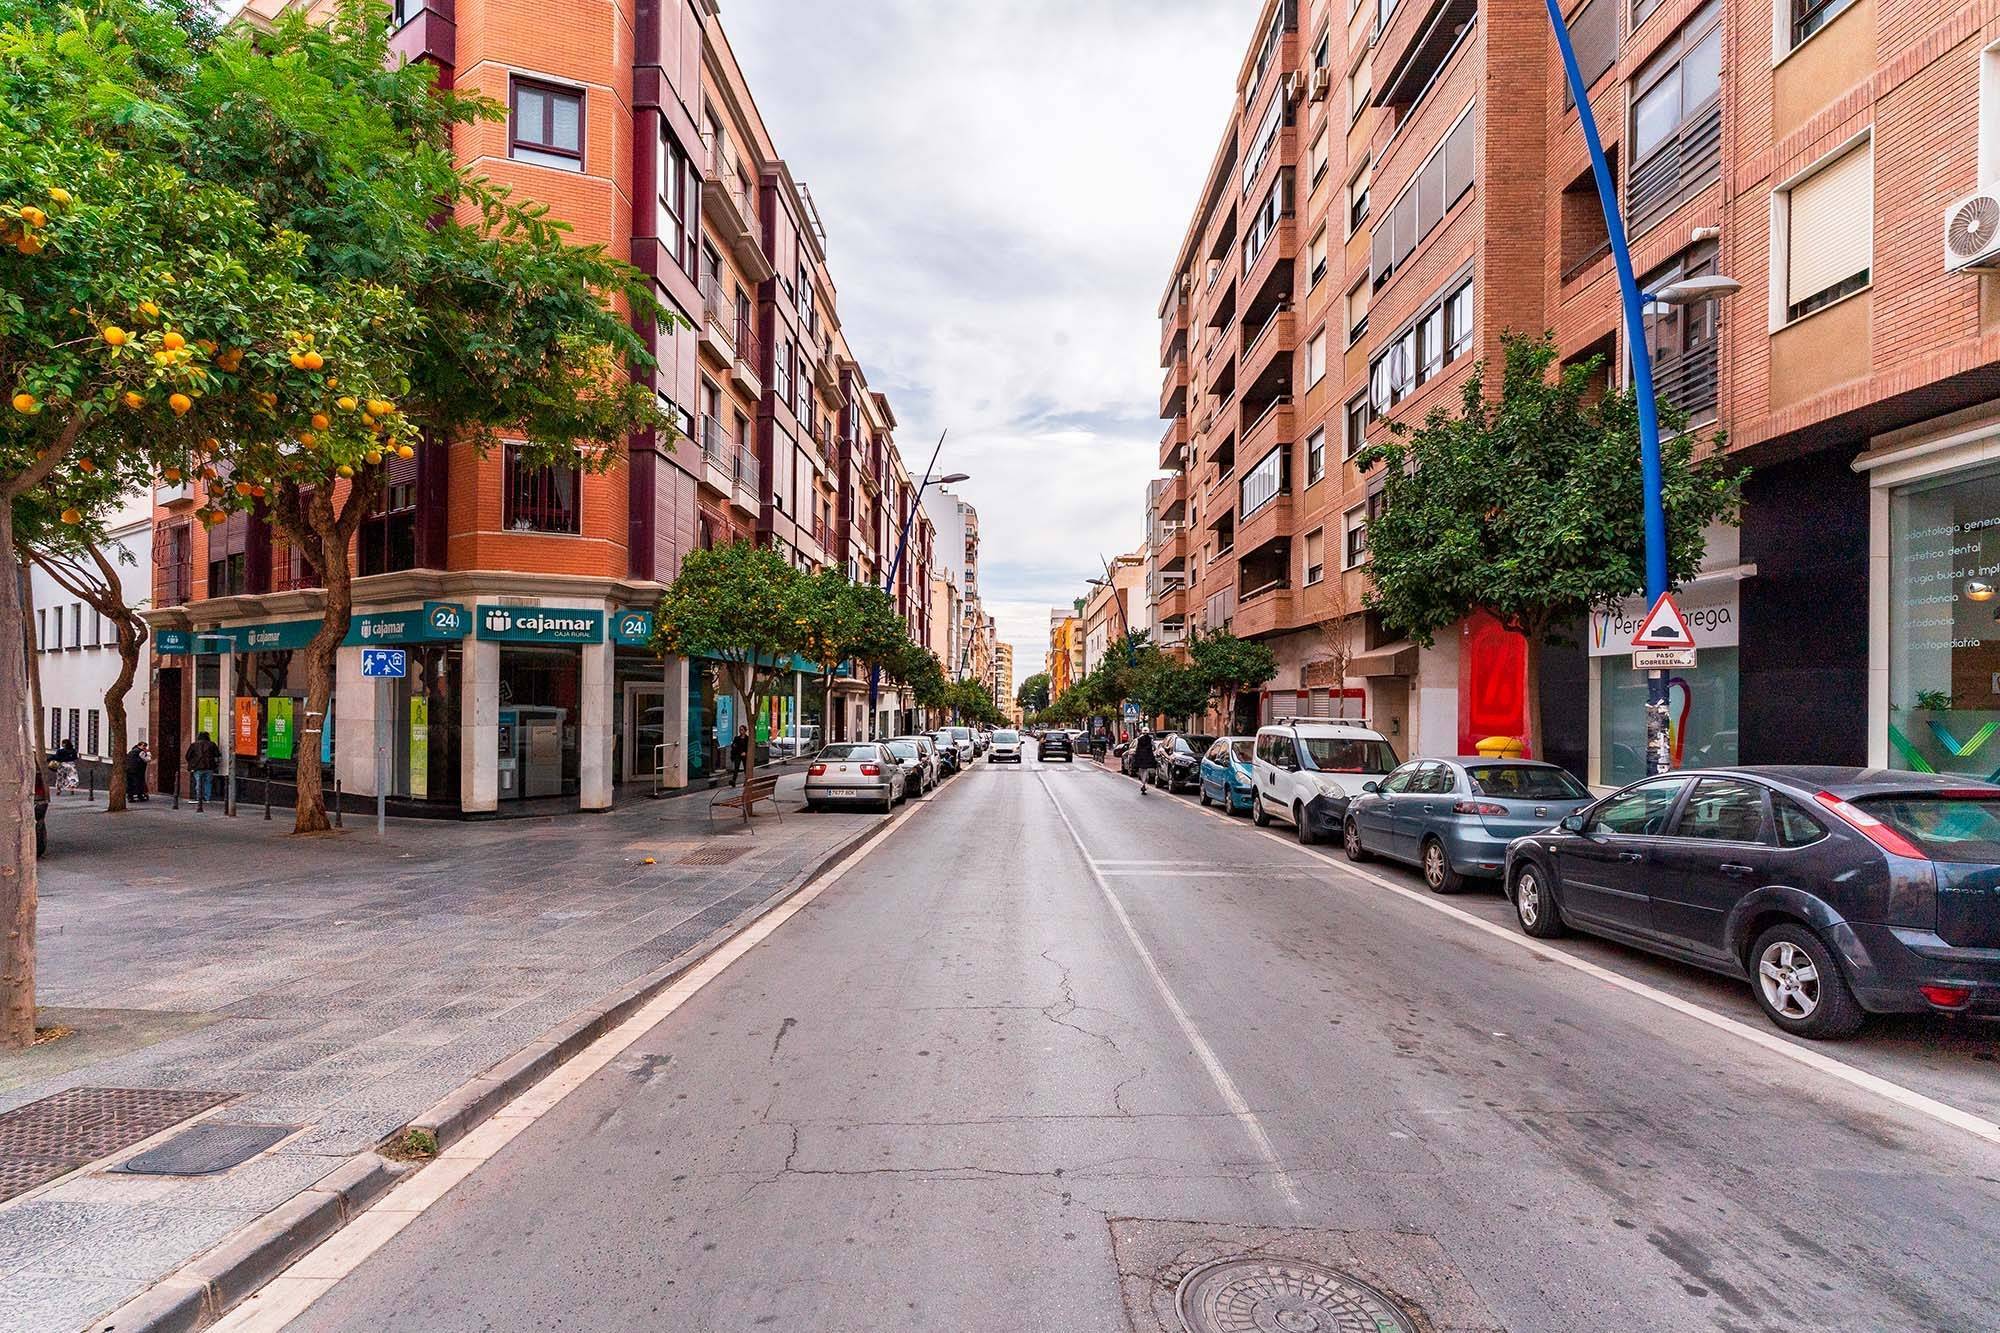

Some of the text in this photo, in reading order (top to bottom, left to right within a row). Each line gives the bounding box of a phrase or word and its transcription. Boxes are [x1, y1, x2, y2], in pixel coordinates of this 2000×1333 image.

[1964, 517, 2000, 533] genera
[1948, 541, 1981, 556] dental
[1937, 567, 1965, 580] bucal
[1967, 569, 1975, 577] e
[1978, 563, 2000, 576] impl
[372, 619, 405, 638] cajamar
[516, 614, 594, 634] cajamar
[1614, 615, 1645, 635] Pére
[257, 629, 281, 645] cajamar
[571, 631, 592, 639] RURAL
